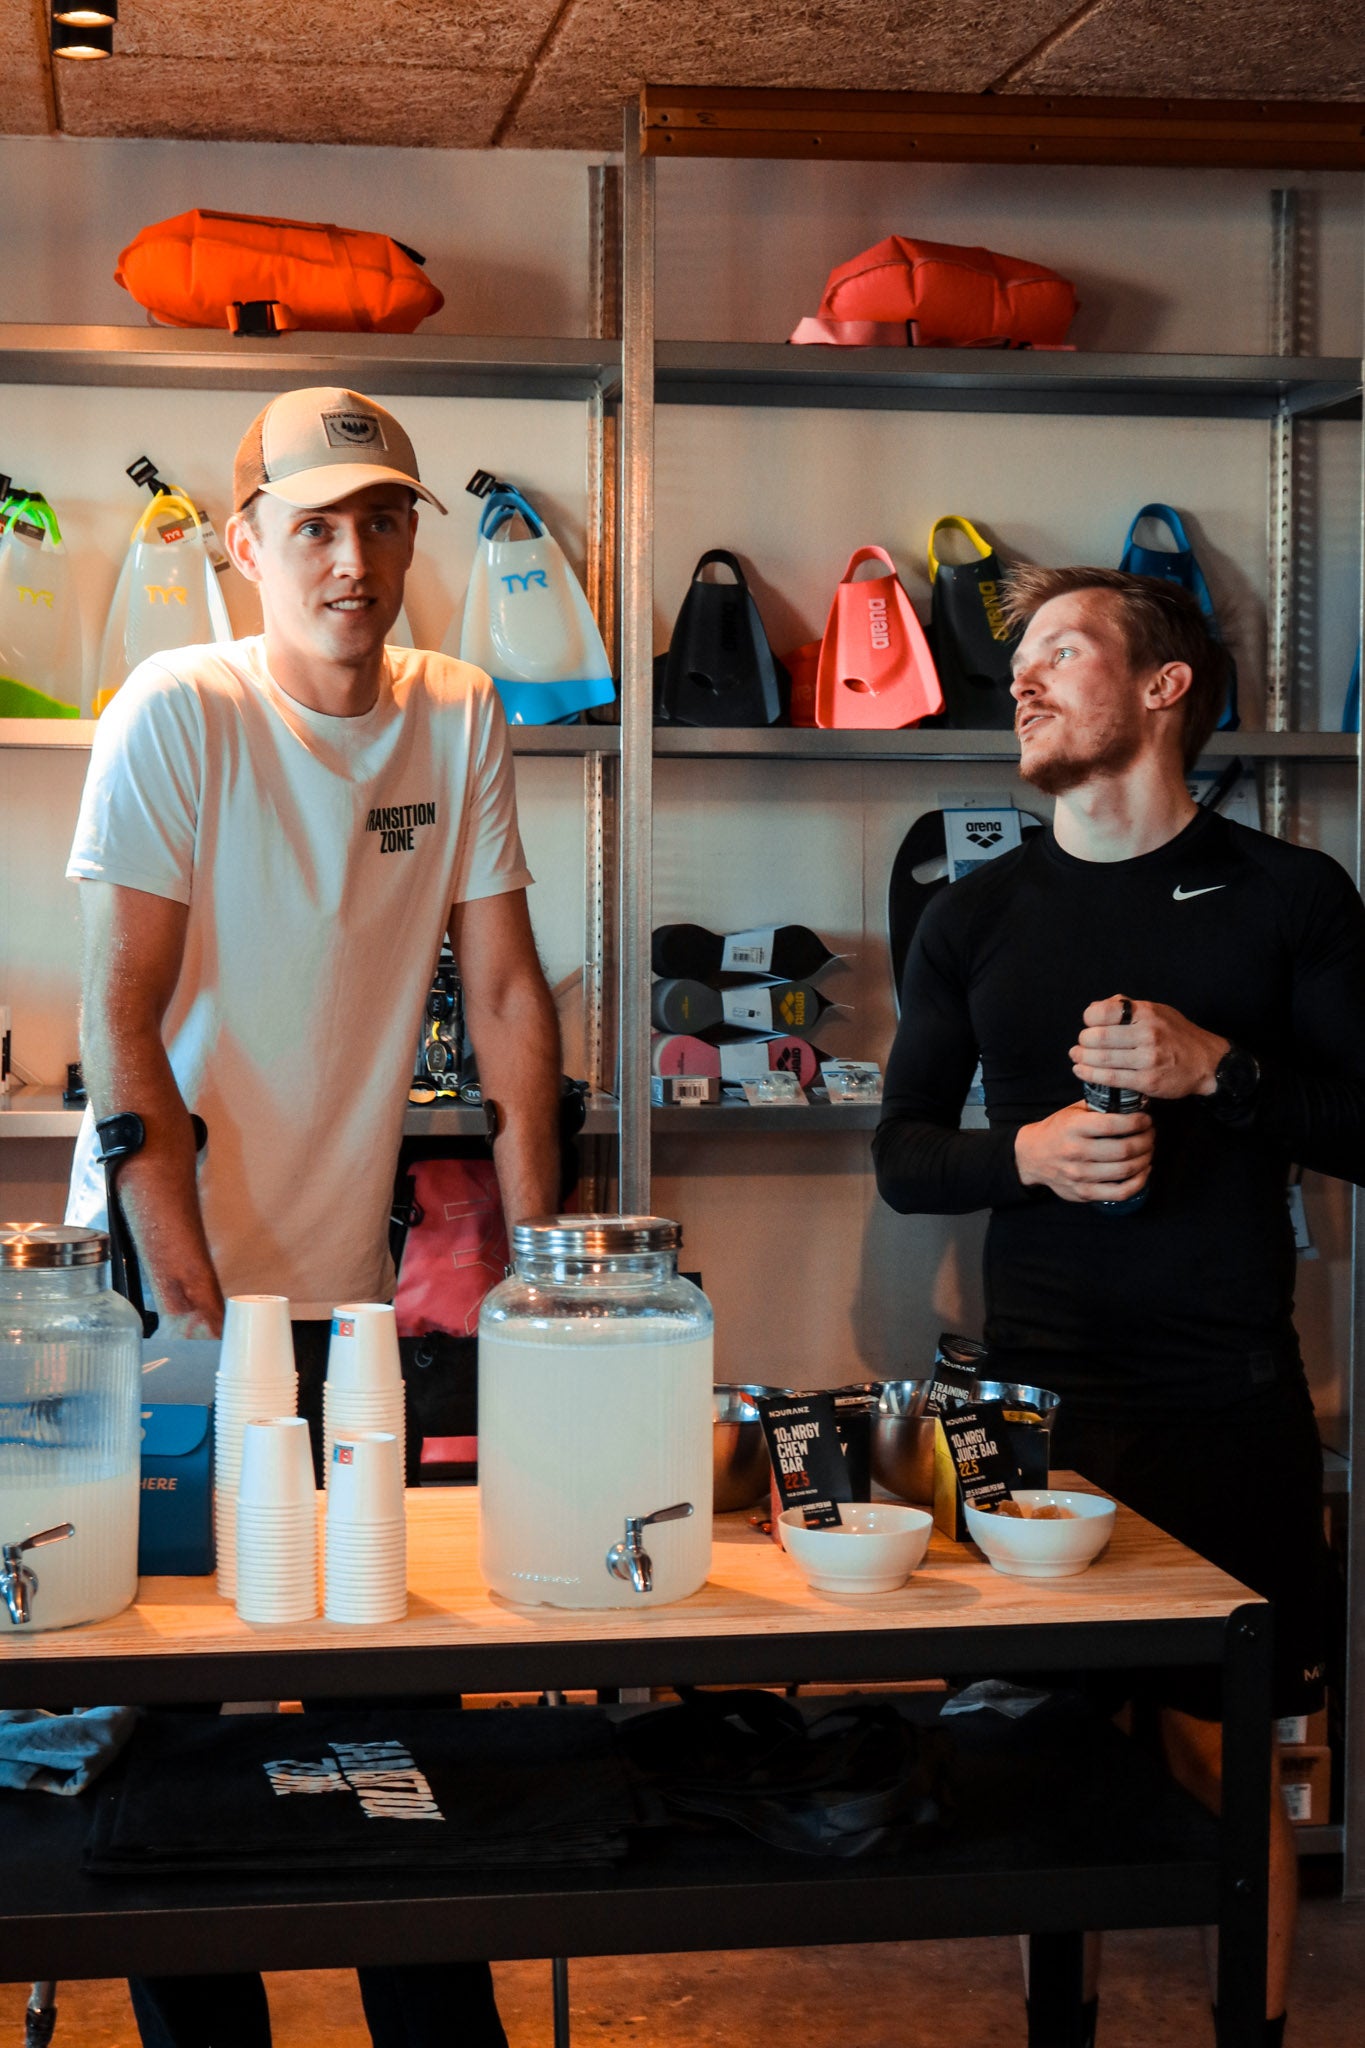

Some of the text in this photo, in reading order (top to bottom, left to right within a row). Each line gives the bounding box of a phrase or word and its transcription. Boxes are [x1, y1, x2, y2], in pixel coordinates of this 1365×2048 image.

[163, 530, 182, 541] TYR
[501, 569, 549, 594] TYR
[16, 585, 55, 609] TYR
[144, 585, 188, 606] TYR
[979, 580, 1009, 641] arena
[868, 598, 890, 650] arena
[365, 802, 436, 832] RANSITION
[965, 821, 1002, 832] arena
[380, 828, 415, 853] ZONE
[795, 992, 805, 1025] arena
[431, 1072, 459, 1085] TYR
[930, 1390, 948, 1404] BAR
[933, 1381, 970, 1401] TRAINING
[790, 1422, 820, 1441] NRGY
[963, 1427, 987, 1447] NRGY
[777, 1440, 809, 1459] CHEW
[956, 1440, 999, 1463] JUICE BAR
[780, 1457, 805, 1474] BAR
[958, 1459, 980, 1477] 22.5
[785, 1472, 811, 1490] 22.5
